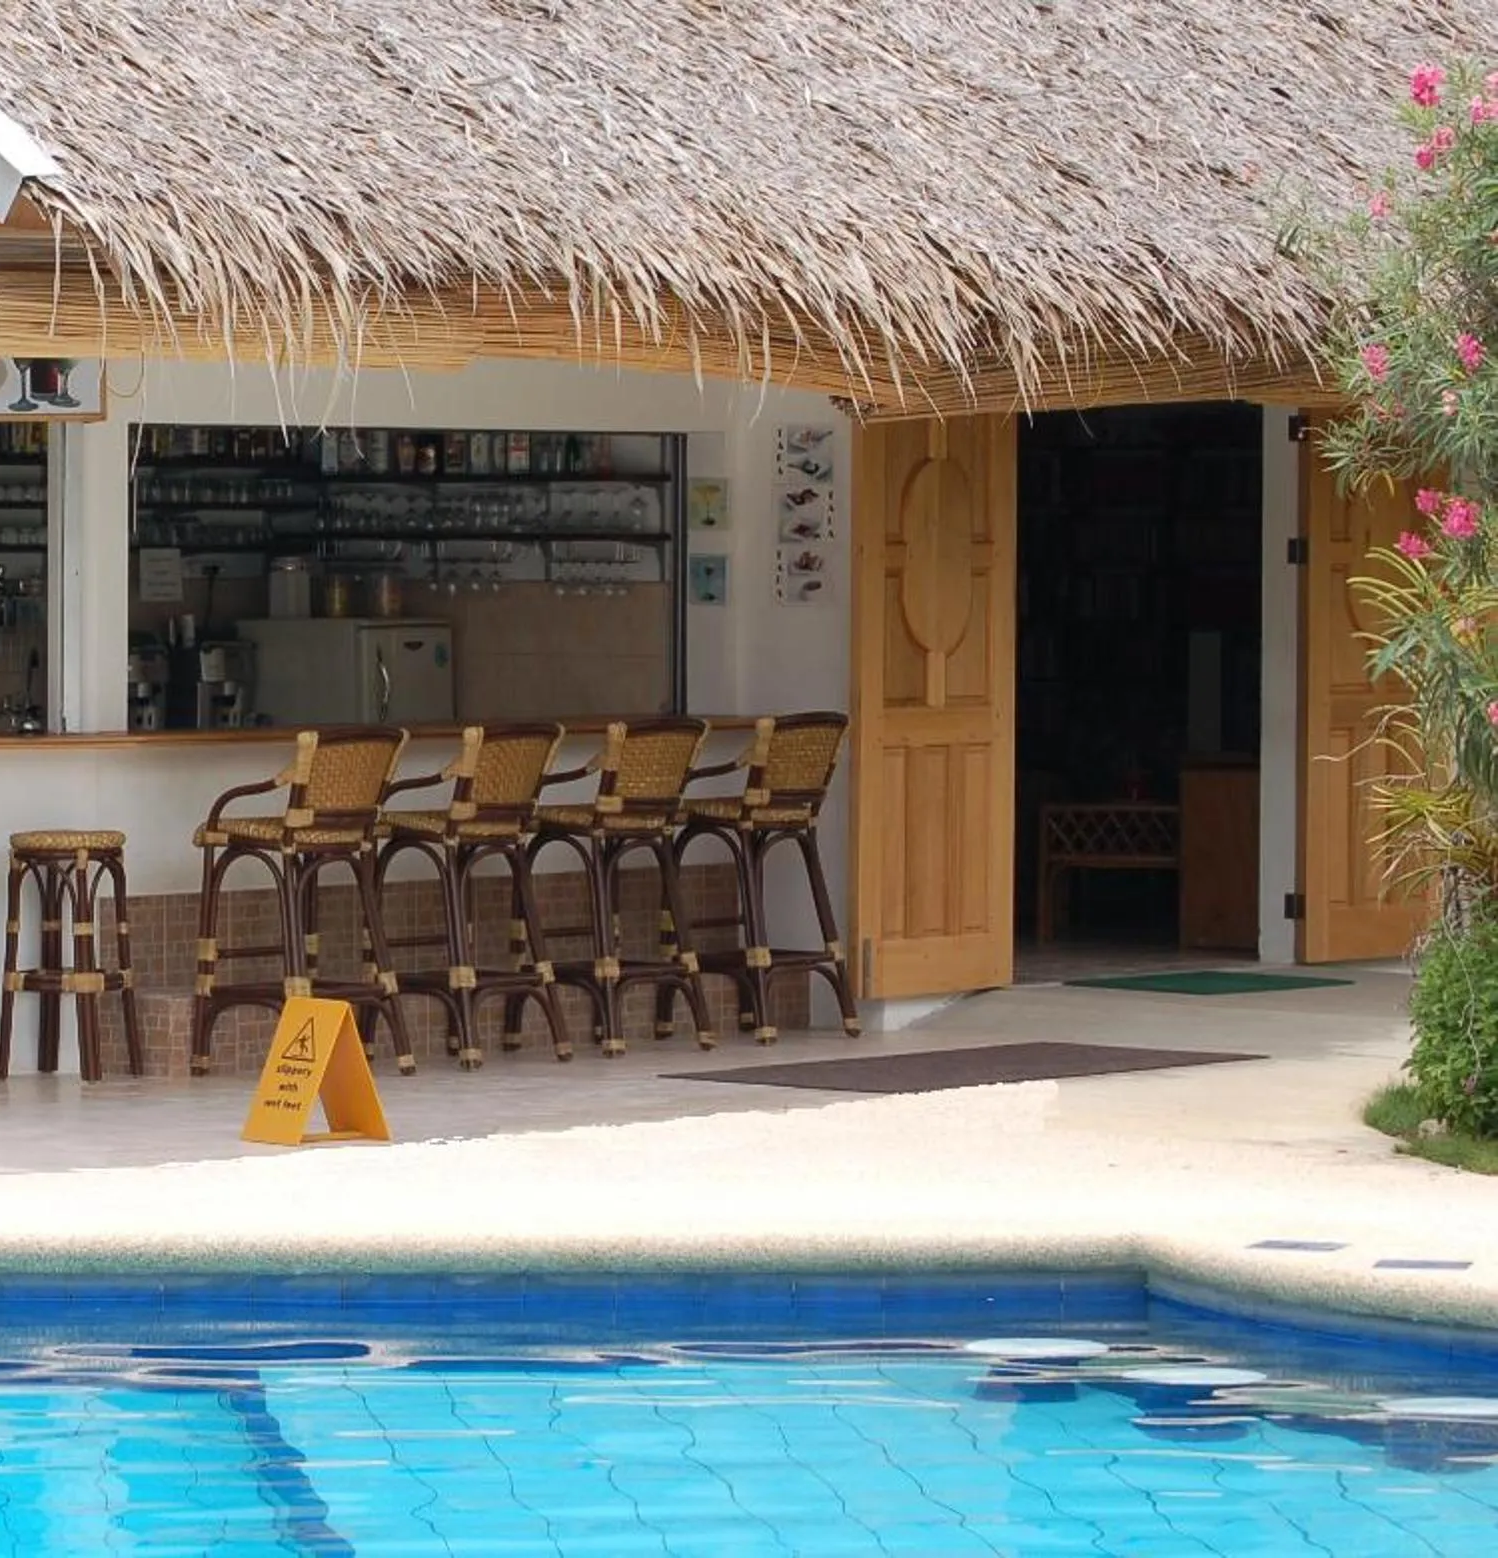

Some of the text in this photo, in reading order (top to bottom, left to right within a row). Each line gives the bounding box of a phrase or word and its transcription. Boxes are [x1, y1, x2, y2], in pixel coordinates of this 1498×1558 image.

[276, 1064, 312, 1079] slippery
[279, 1082, 298, 1092] with
[264, 1099, 302, 1111] wet feet
